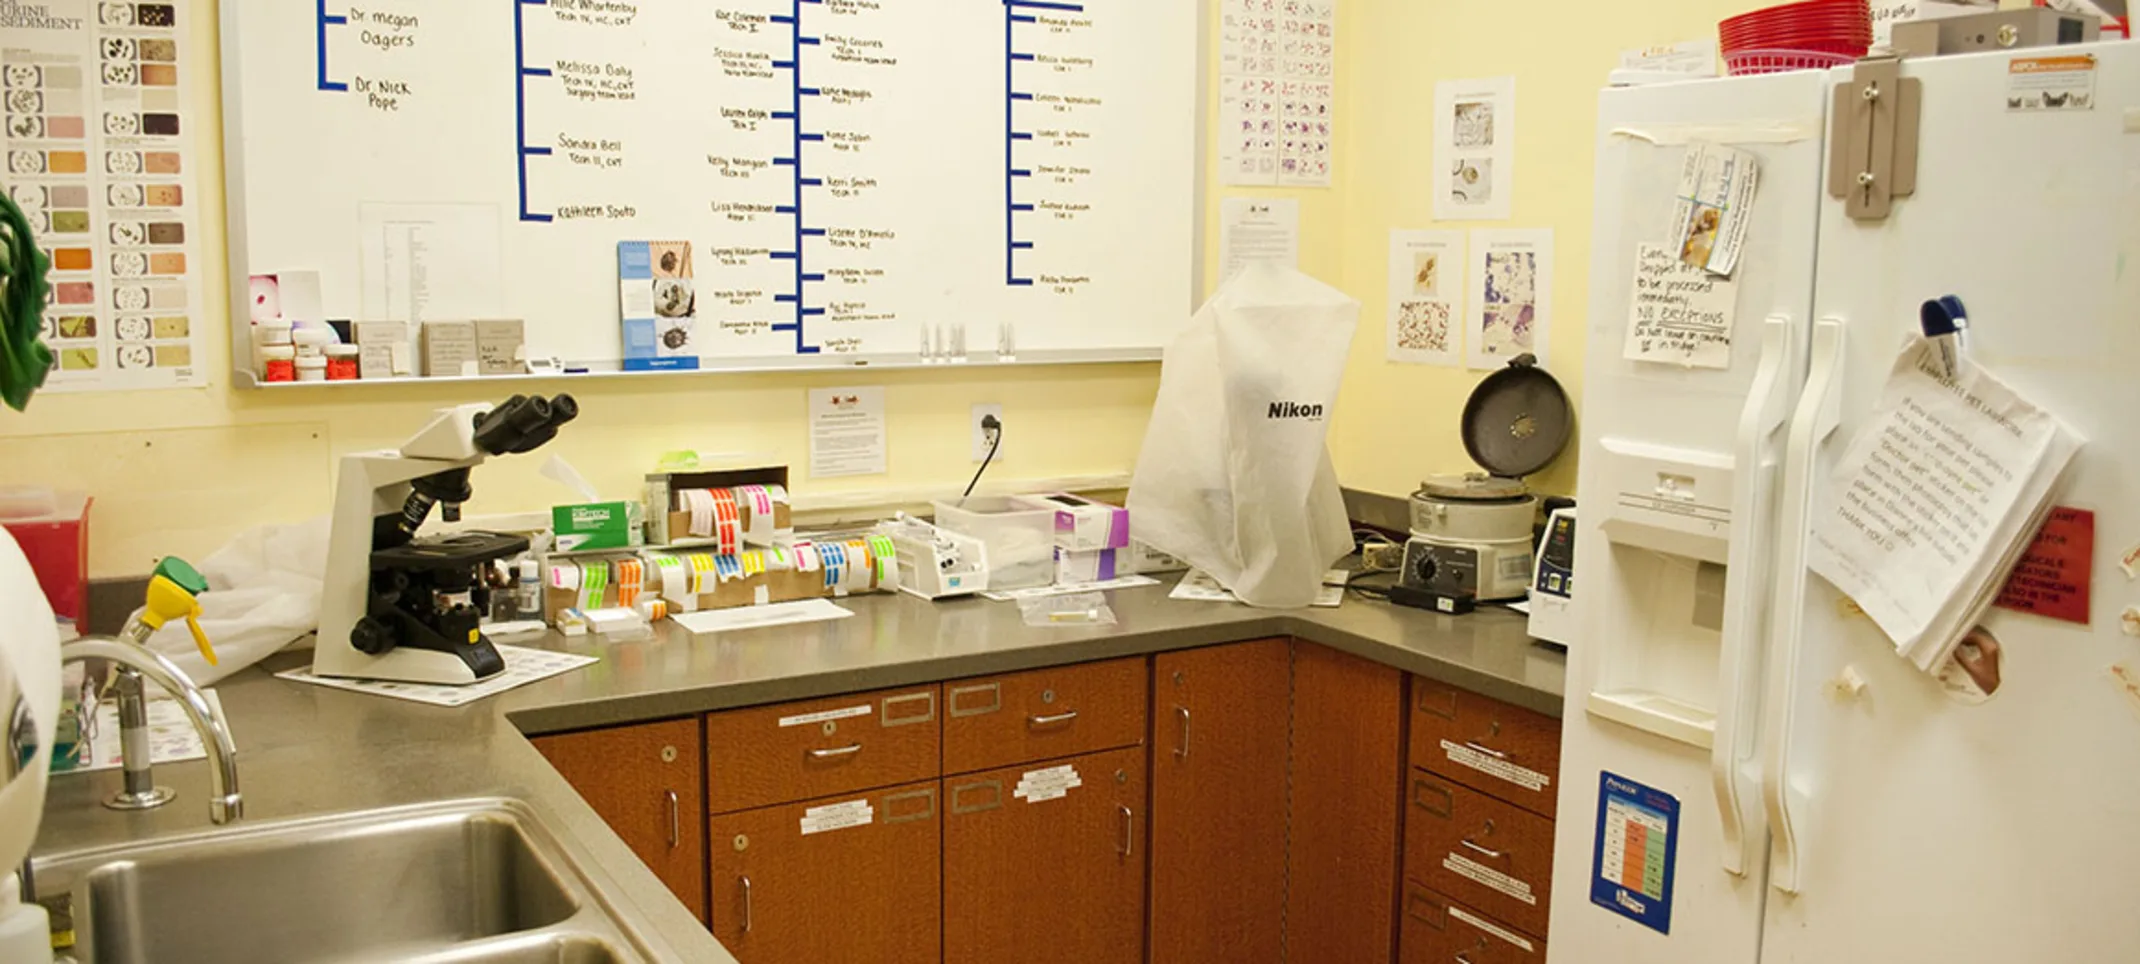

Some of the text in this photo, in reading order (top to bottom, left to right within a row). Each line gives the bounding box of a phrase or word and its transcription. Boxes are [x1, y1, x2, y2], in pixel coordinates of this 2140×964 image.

[1, 16, 83, 30] SEDIMENT
[372, 12, 418, 32] megan
[556, 60, 600, 75] Melissa
[368, 92, 398, 111] Pope
[558, 205, 604, 219] Kathleen
[1637, 277, 1647, 288] to
[1650, 278, 1661, 290] be
[1661, 306, 1725, 324] EXCEPTIONS
[1268, 401, 1323, 418] Nikon
